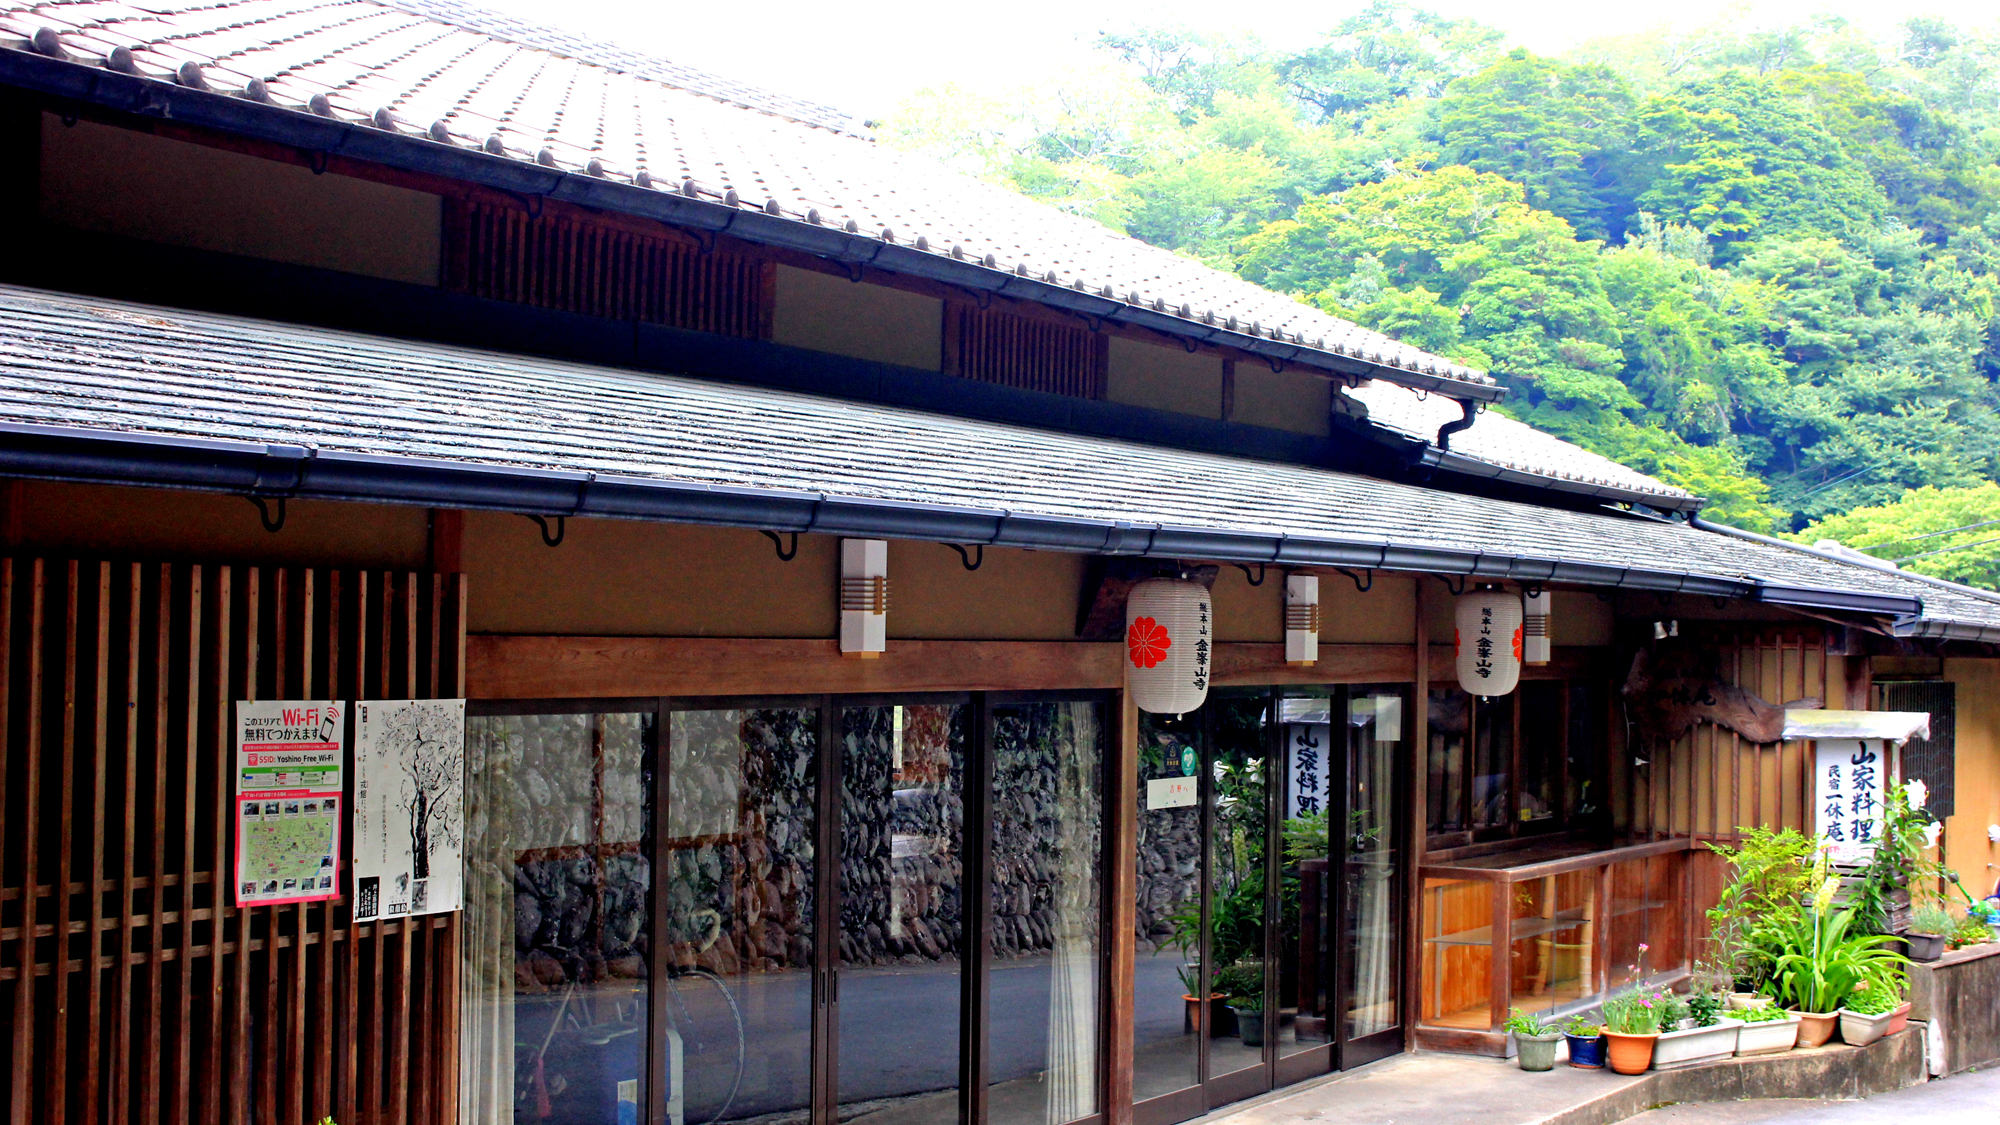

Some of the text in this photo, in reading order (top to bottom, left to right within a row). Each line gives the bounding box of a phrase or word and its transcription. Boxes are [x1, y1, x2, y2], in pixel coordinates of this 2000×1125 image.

[244, 707, 319, 727] このエリアで Wi-Fi
[244, 727, 319, 741] 無料でつかえます
[259, 754, 334, 765] SSID: Yoshino_Free_Wi-Fi
[1850, 740, 1877, 842] 山家料理
